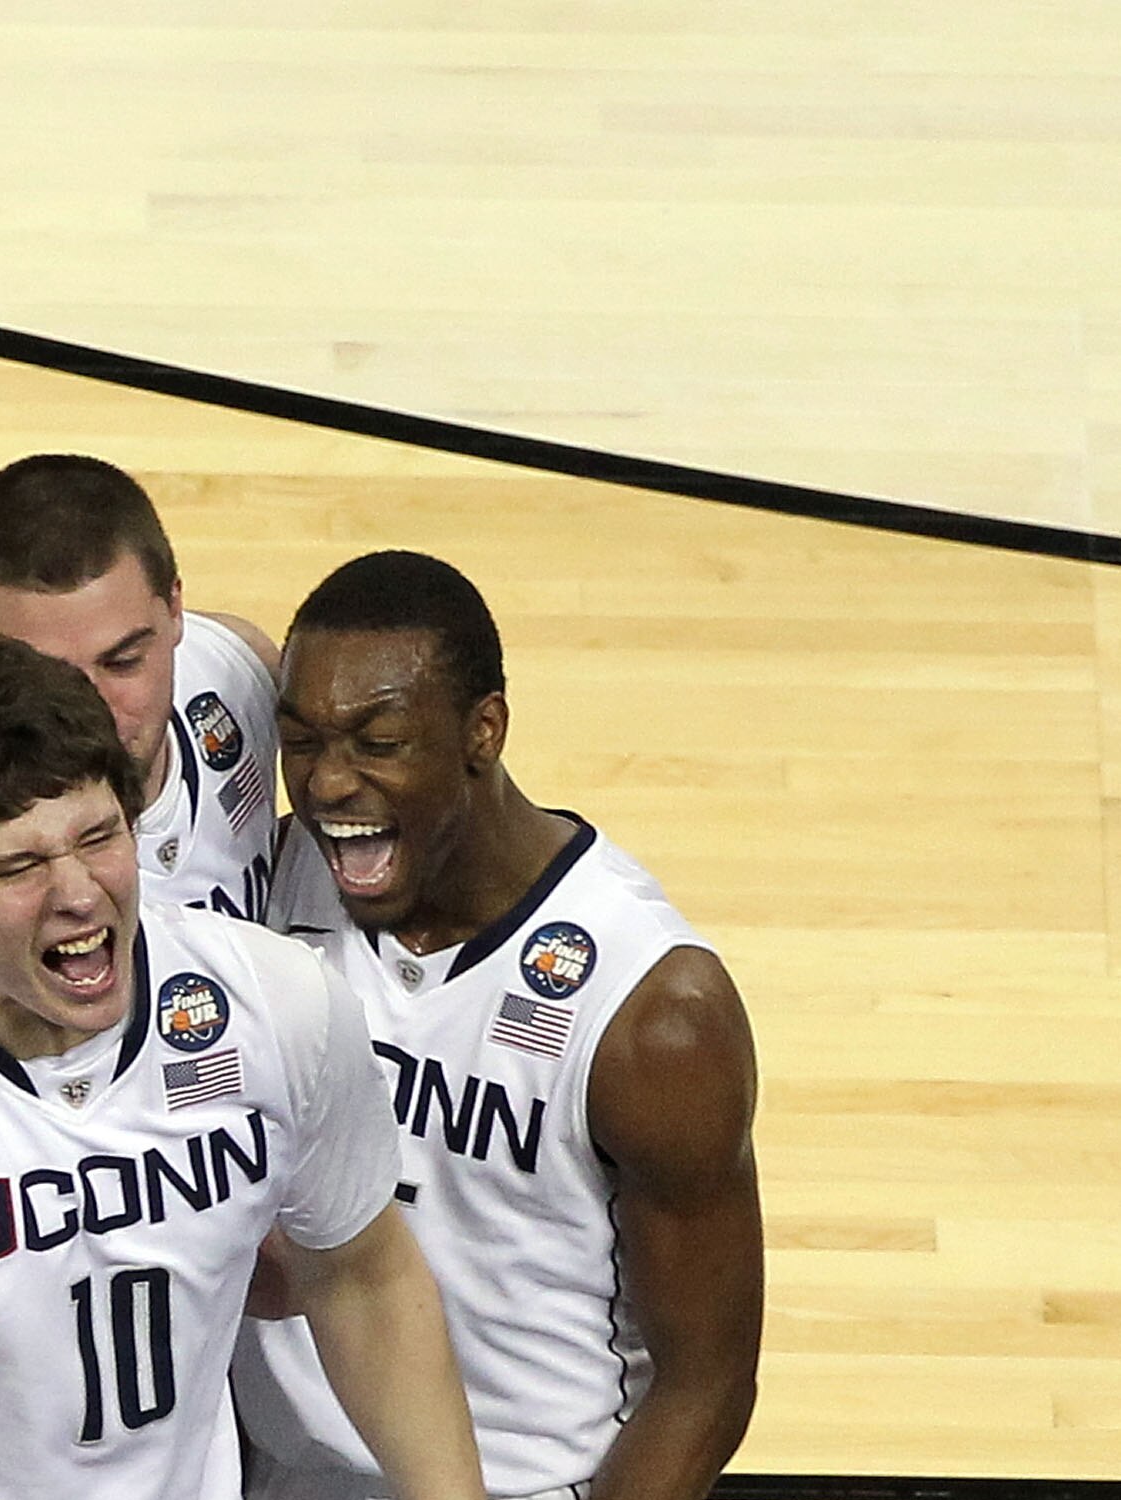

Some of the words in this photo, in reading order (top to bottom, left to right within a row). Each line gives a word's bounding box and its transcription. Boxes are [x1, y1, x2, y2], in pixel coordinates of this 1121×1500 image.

[523, 943, 584, 981] FOUR
[546, 938, 589, 964] FINAL
[172, 989, 214, 1010] FINAL
[161, 1003, 219, 1035] FOUR
[70, 1267, 176, 1443] 10
